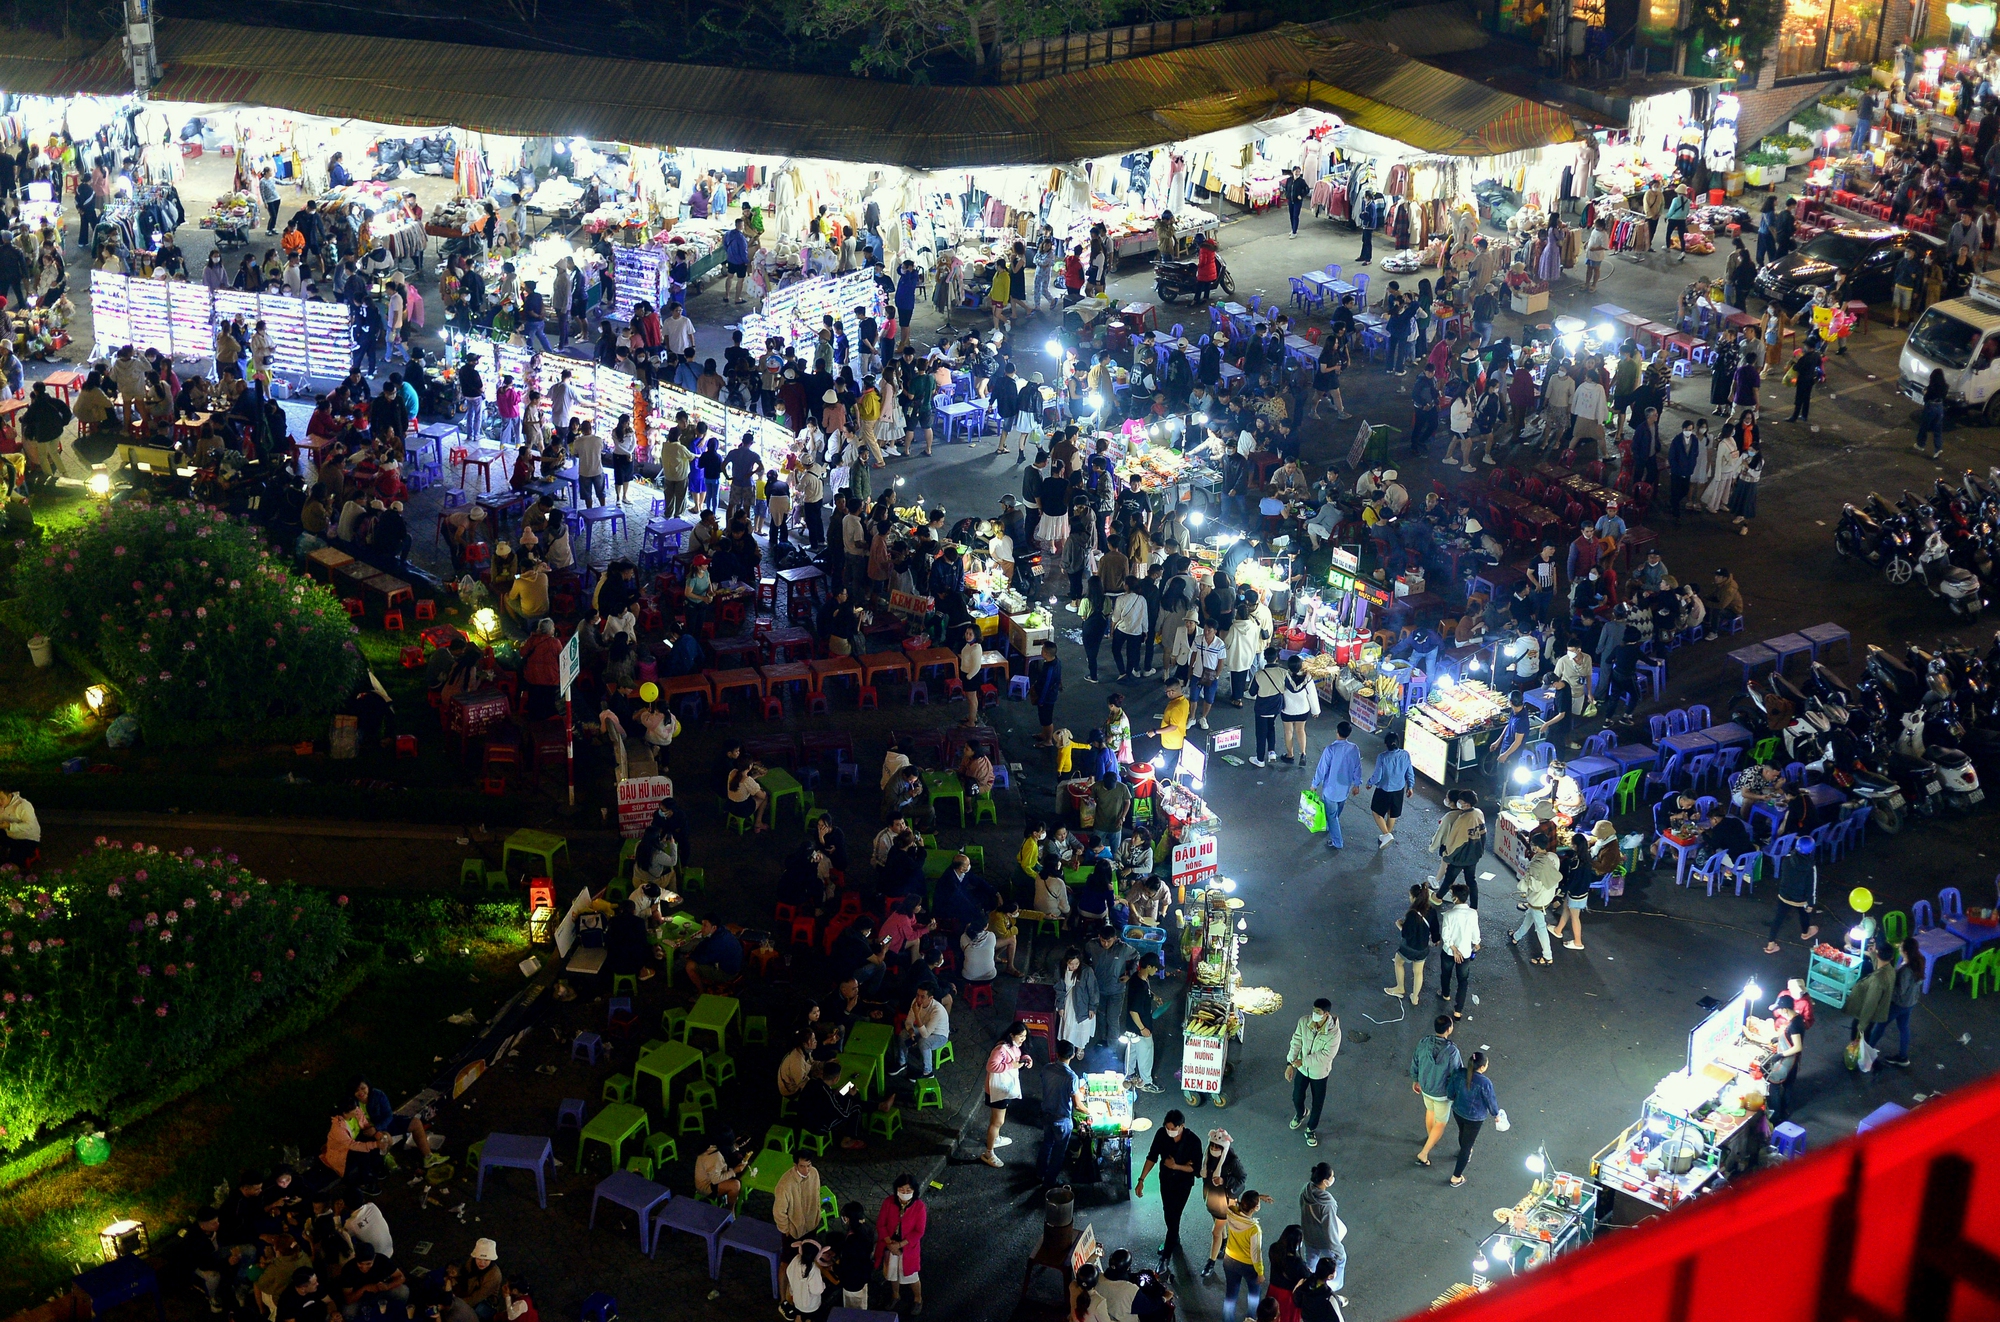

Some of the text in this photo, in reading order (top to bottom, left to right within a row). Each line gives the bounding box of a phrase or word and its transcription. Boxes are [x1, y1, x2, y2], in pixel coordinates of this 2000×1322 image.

[891, 591, 912, 610] KEM
[620, 781, 637, 804] ĐẬU
[651, 781, 671, 798] NÓNG
[631, 802, 660, 812] SÚP CUA
[1174, 846, 1197, 863] ĐẬU
[1185, 859, 1203, 871] NÓNG
[1173, 874, 1194, 887] SÚP
[1194, 1049, 1214, 1062] NƯỚNG
[1183, 1077, 1204, 1090] KEM
